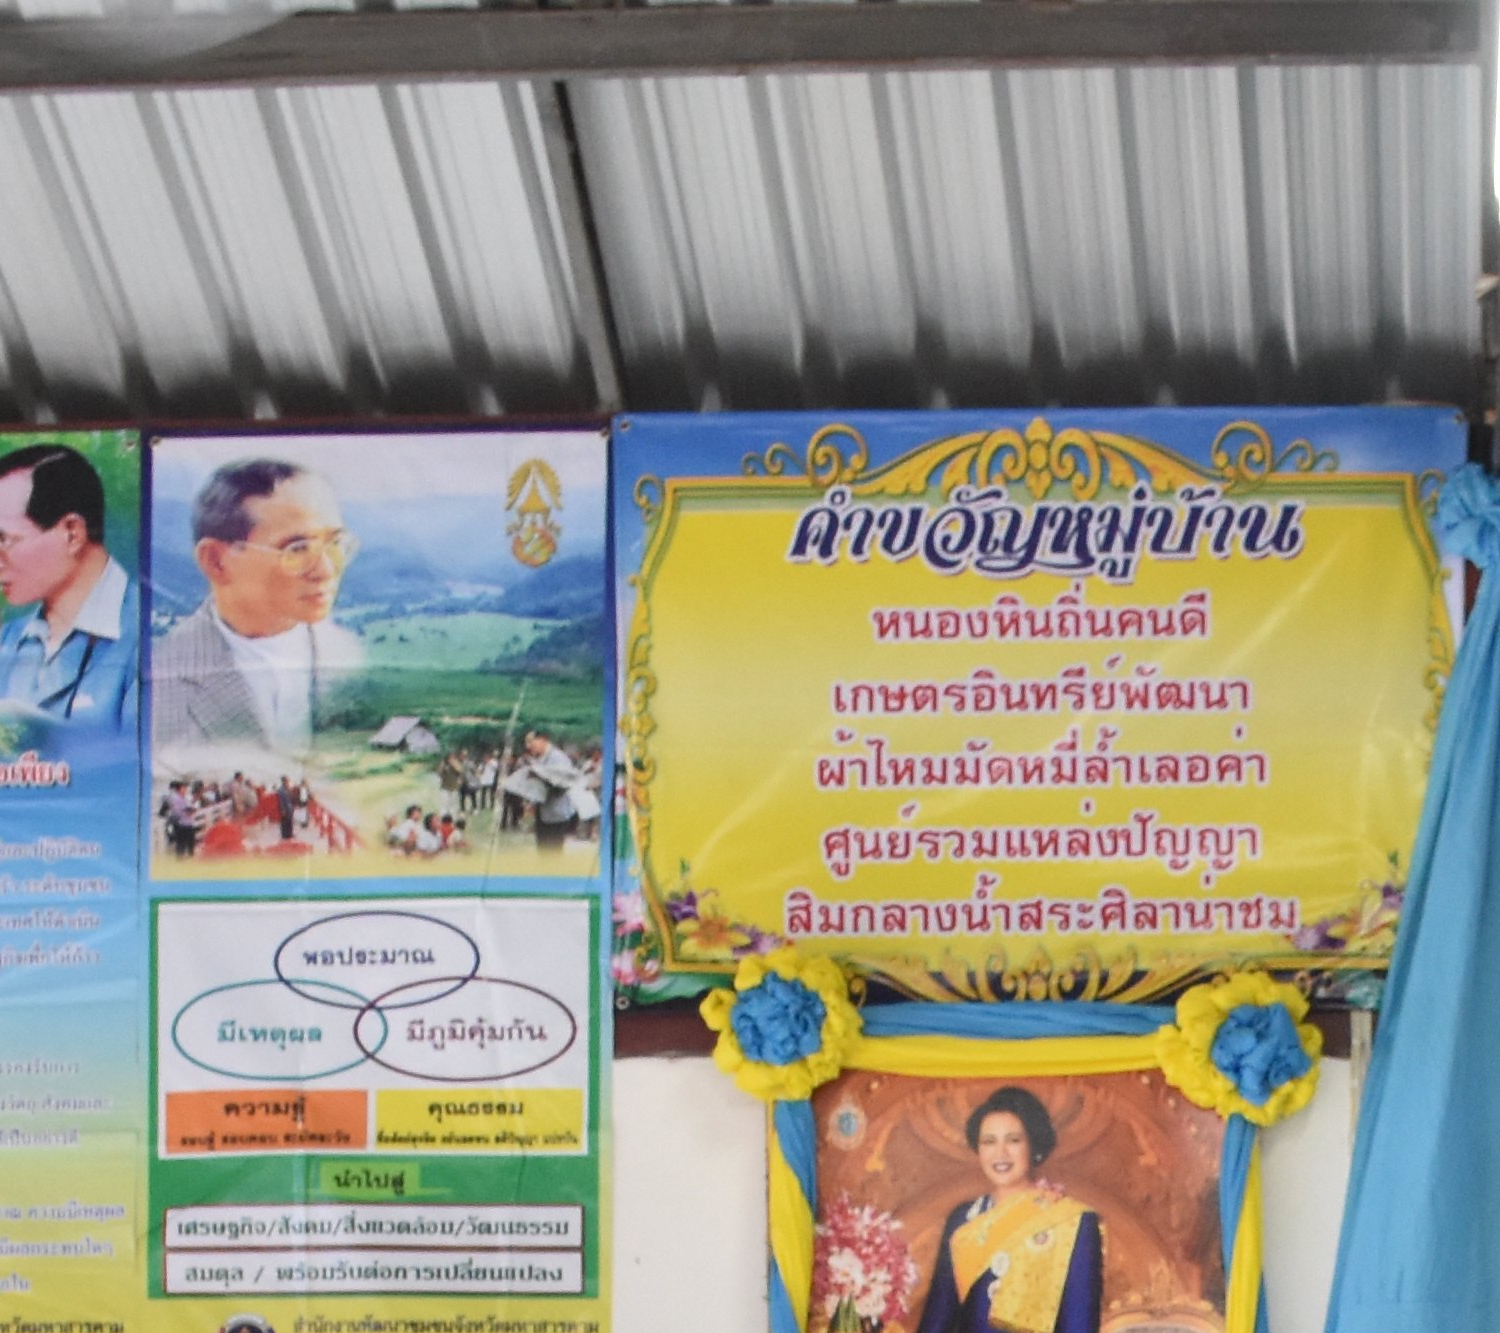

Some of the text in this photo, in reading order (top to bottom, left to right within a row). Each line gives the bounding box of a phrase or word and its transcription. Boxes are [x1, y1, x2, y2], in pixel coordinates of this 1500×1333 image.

[788, 483, 1303, 583] คำขวัญหมู่บ้าน
[873, 585, 1210, 641] หนองหินถิ่นคนดี
[833, 657, 1251, 715] เกษตรอินทรีย์พัฒนา
[817, 725, 1269, 788] ผ้าไหมมัดหมี่ล้ำเลอค่า
[823, 804, 1260, 874] ศูนย์รวมแหล่งปัญญา
[786, 874, 1299, 938] สิมกลางน้ำสระศิลาน่าชม
[302, 946, 436, 966] พอประมาณ
[217, 1019, 323, 1053] มีเหตุผล
[407, 1018, 548, 1054] มีภูมิคุ้มกัน
